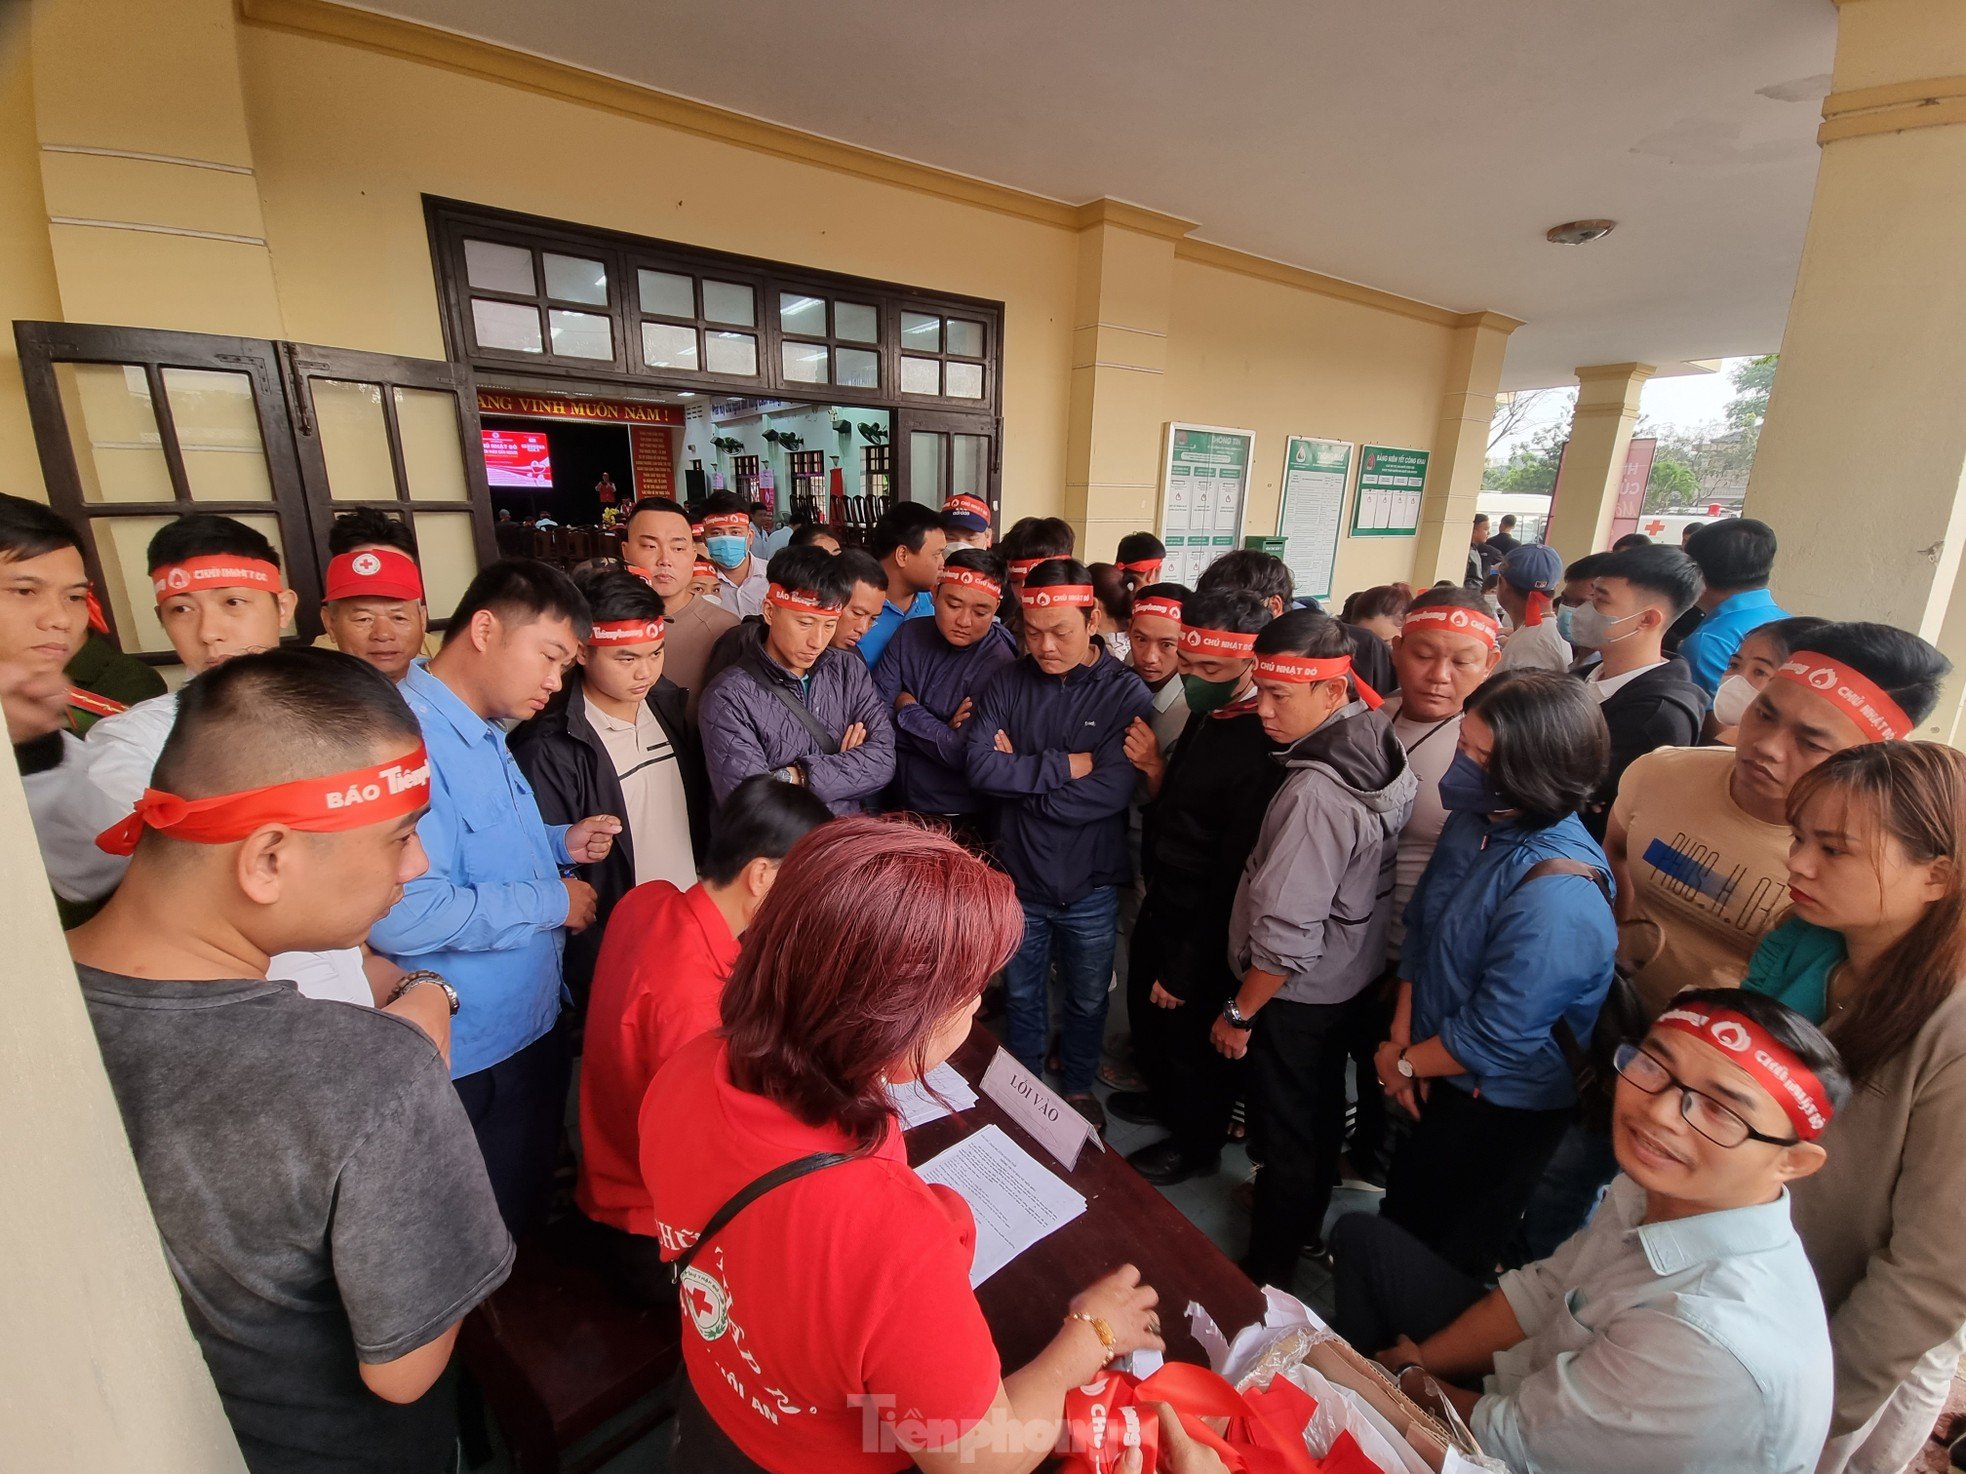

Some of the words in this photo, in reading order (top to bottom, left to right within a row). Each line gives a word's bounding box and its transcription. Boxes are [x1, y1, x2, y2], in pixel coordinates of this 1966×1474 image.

[519, 398, 566, 414] VINH
[570, 402, 619, 418] MUÔN
[325, 783, 382, 809] BÁO
[1033, 1092, 1059, 1122] VÀO
